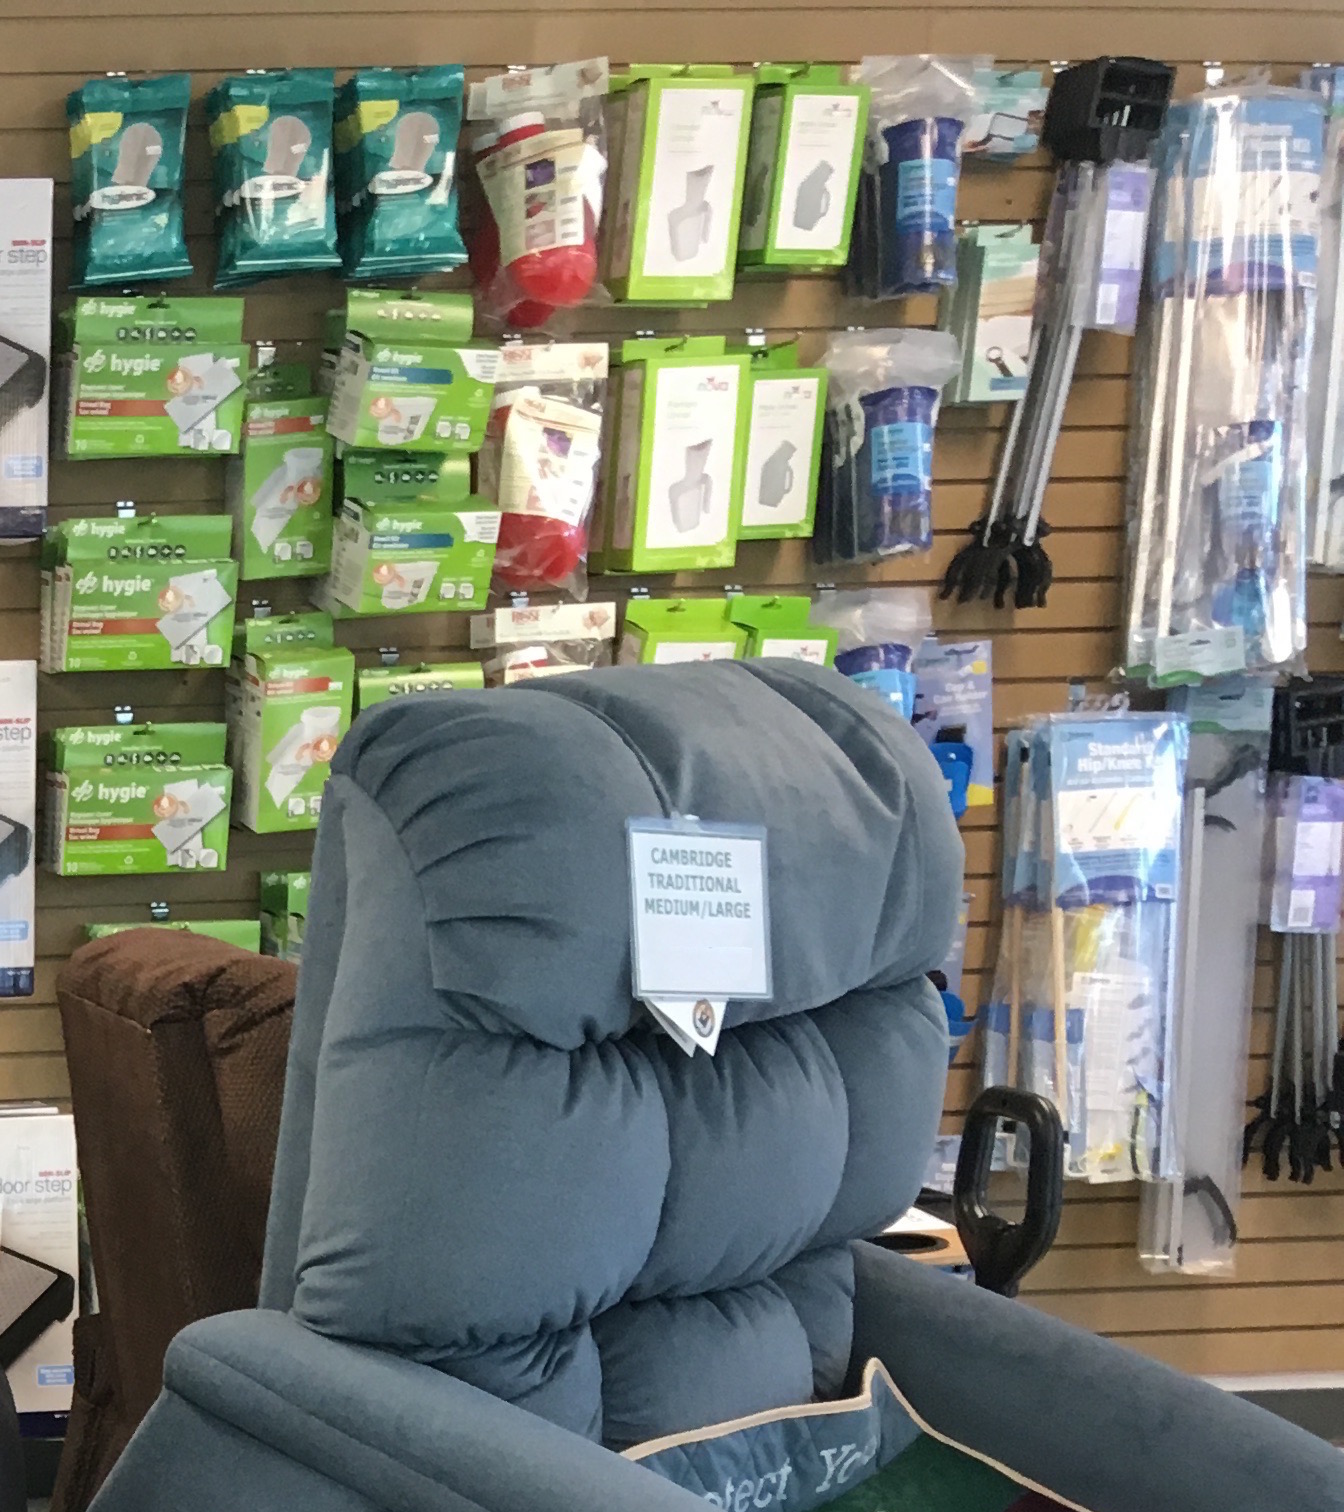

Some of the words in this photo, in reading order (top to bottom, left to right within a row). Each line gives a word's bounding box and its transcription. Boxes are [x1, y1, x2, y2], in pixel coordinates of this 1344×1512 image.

[7, 248, 48, 267] step
[110, 353, 161, 376] hygie
[91, 521, 126, 535] hygie
[102, 574, 152, 596] hygie
[86, 730, 123, 746] hygie
[1077, 757, 1143, 774] Hip/Knee
[98, 781, 148, 804] hygie
[650, 847, 733, 869] CAMBRIDGE
[647, 872, 742, 894] TRADITIONAL
[644, 897, 752, 920] MEDIUM/LARGE
[35, 1178, 72, 1195] step
